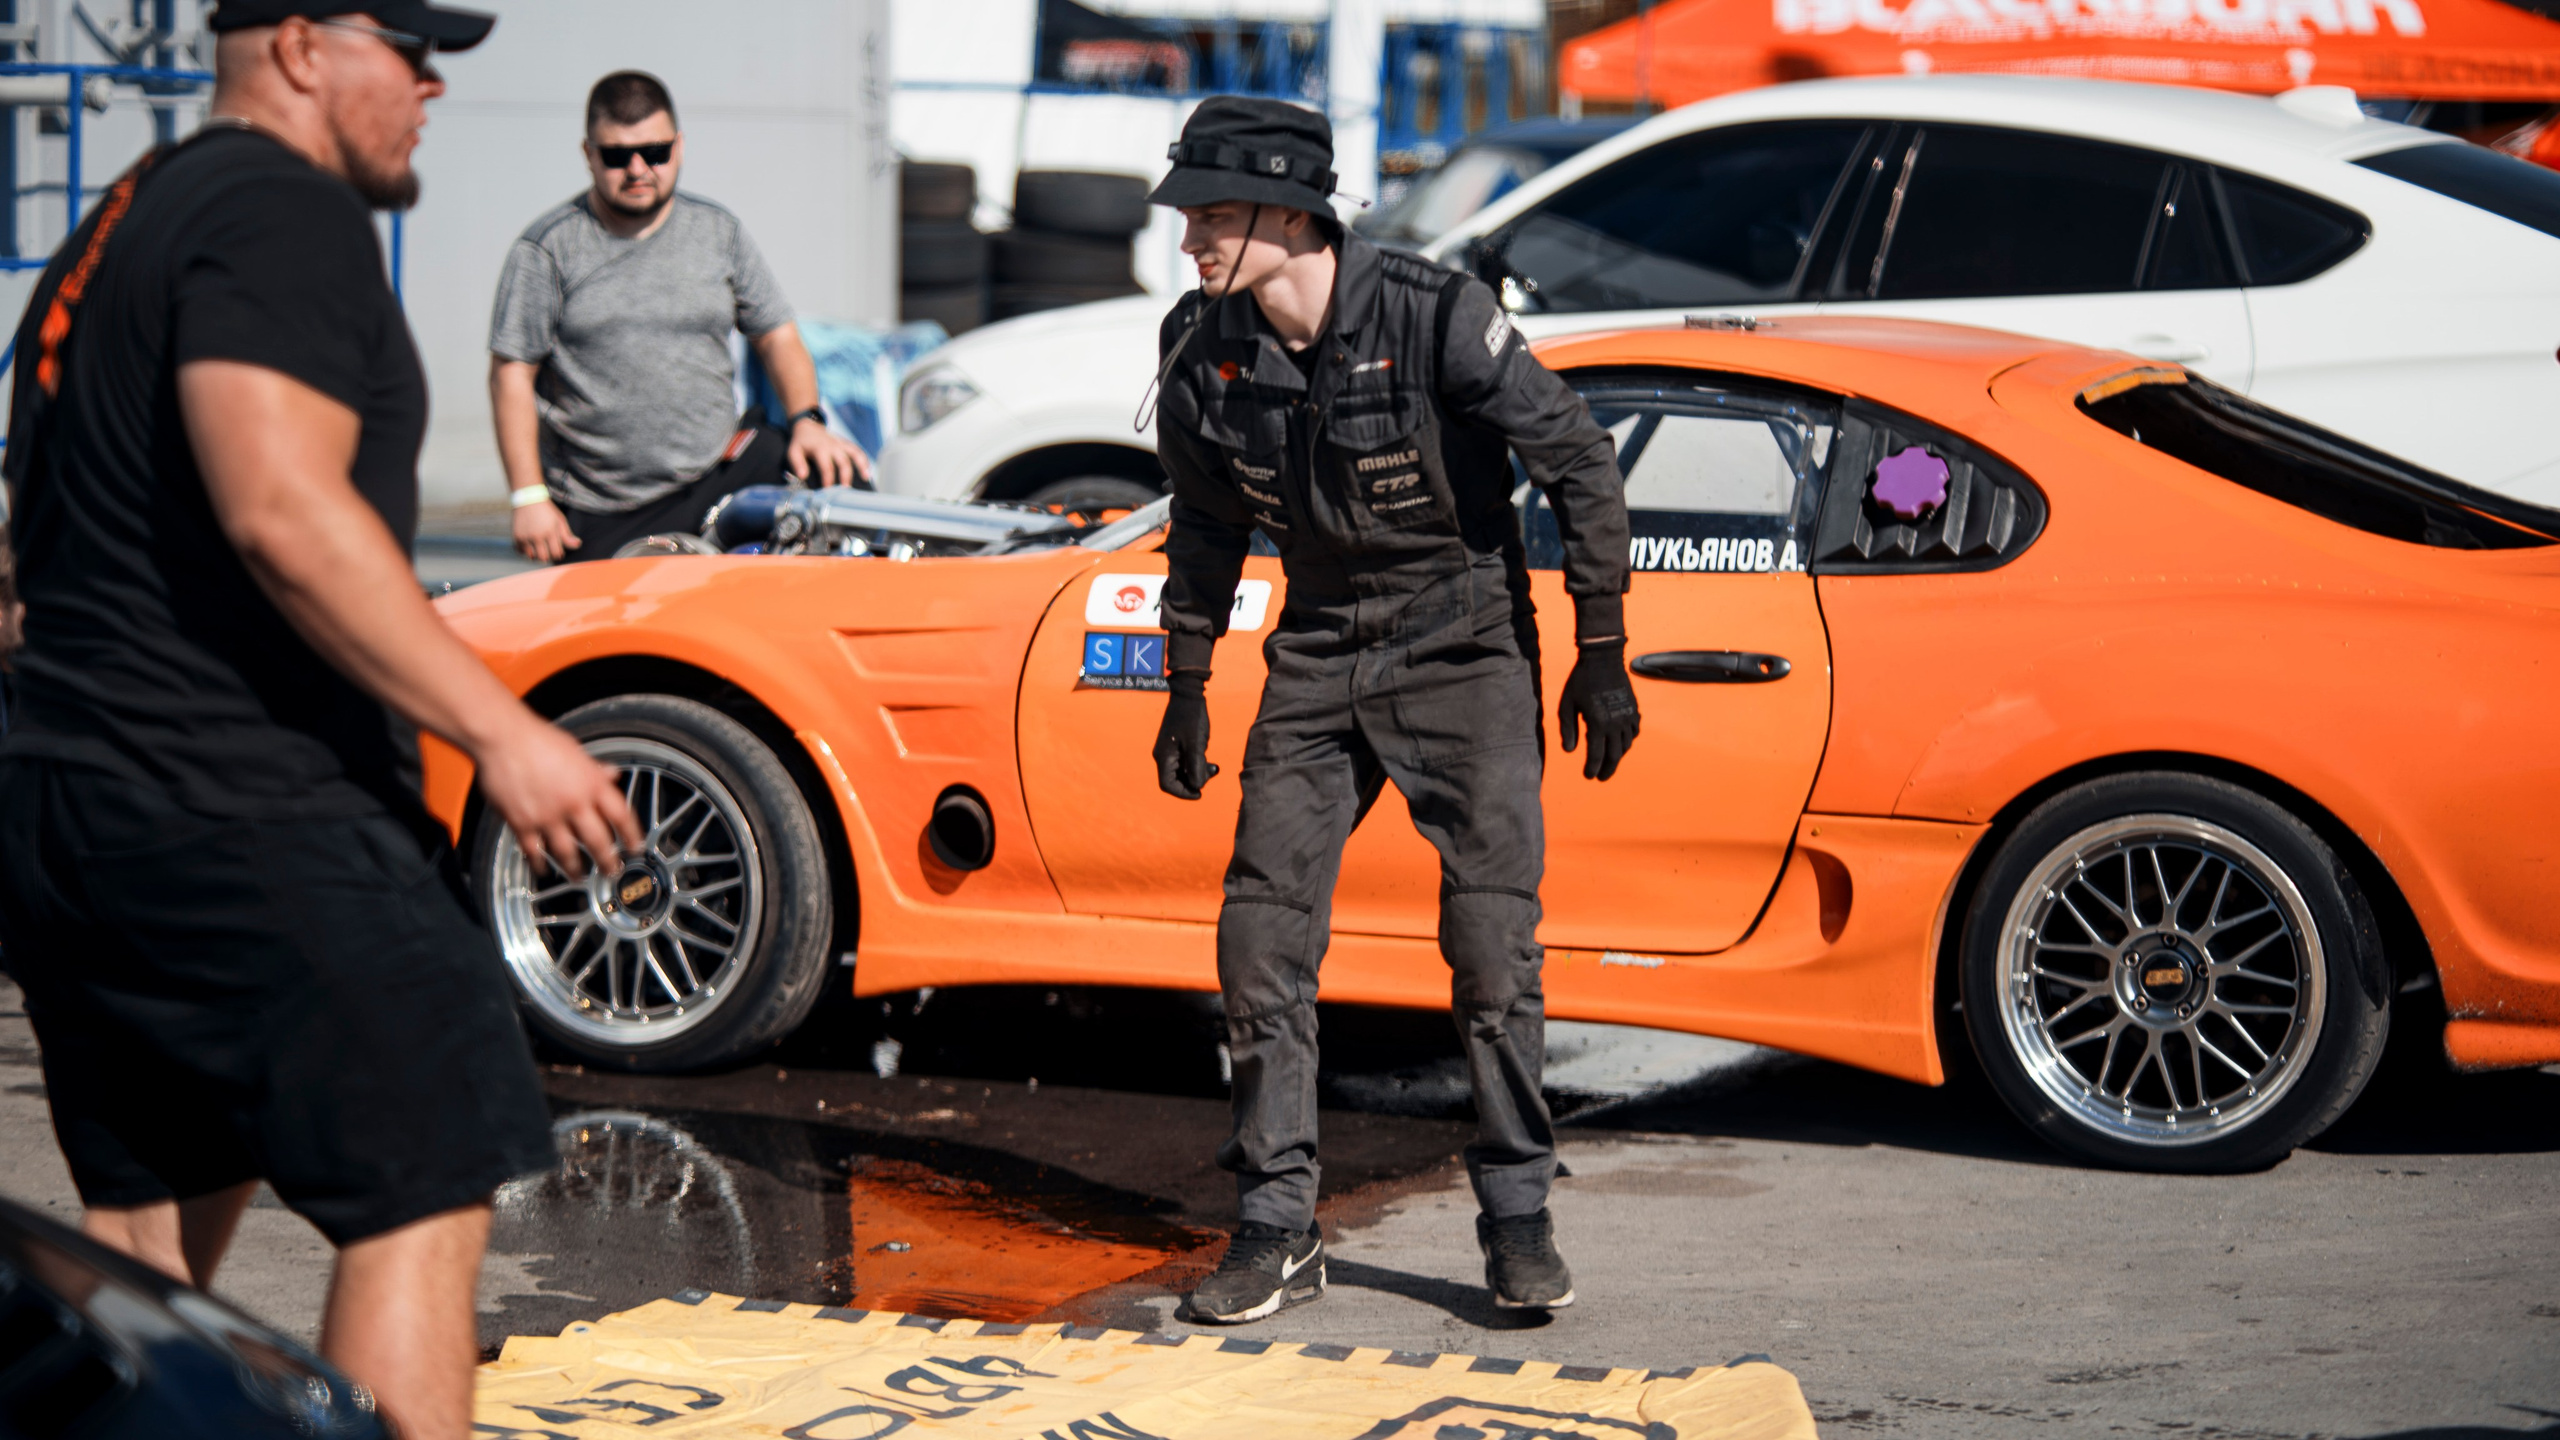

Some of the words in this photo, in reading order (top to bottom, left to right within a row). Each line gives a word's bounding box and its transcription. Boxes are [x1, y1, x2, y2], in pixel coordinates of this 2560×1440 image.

[1357, 449, 1419, 471] MAHLE
[1629, 536, 1775, 572] ЛУКЬЯНОВ
[1084, 674, 1123, 687] Service
[1124, 676, 1134, 687] &
